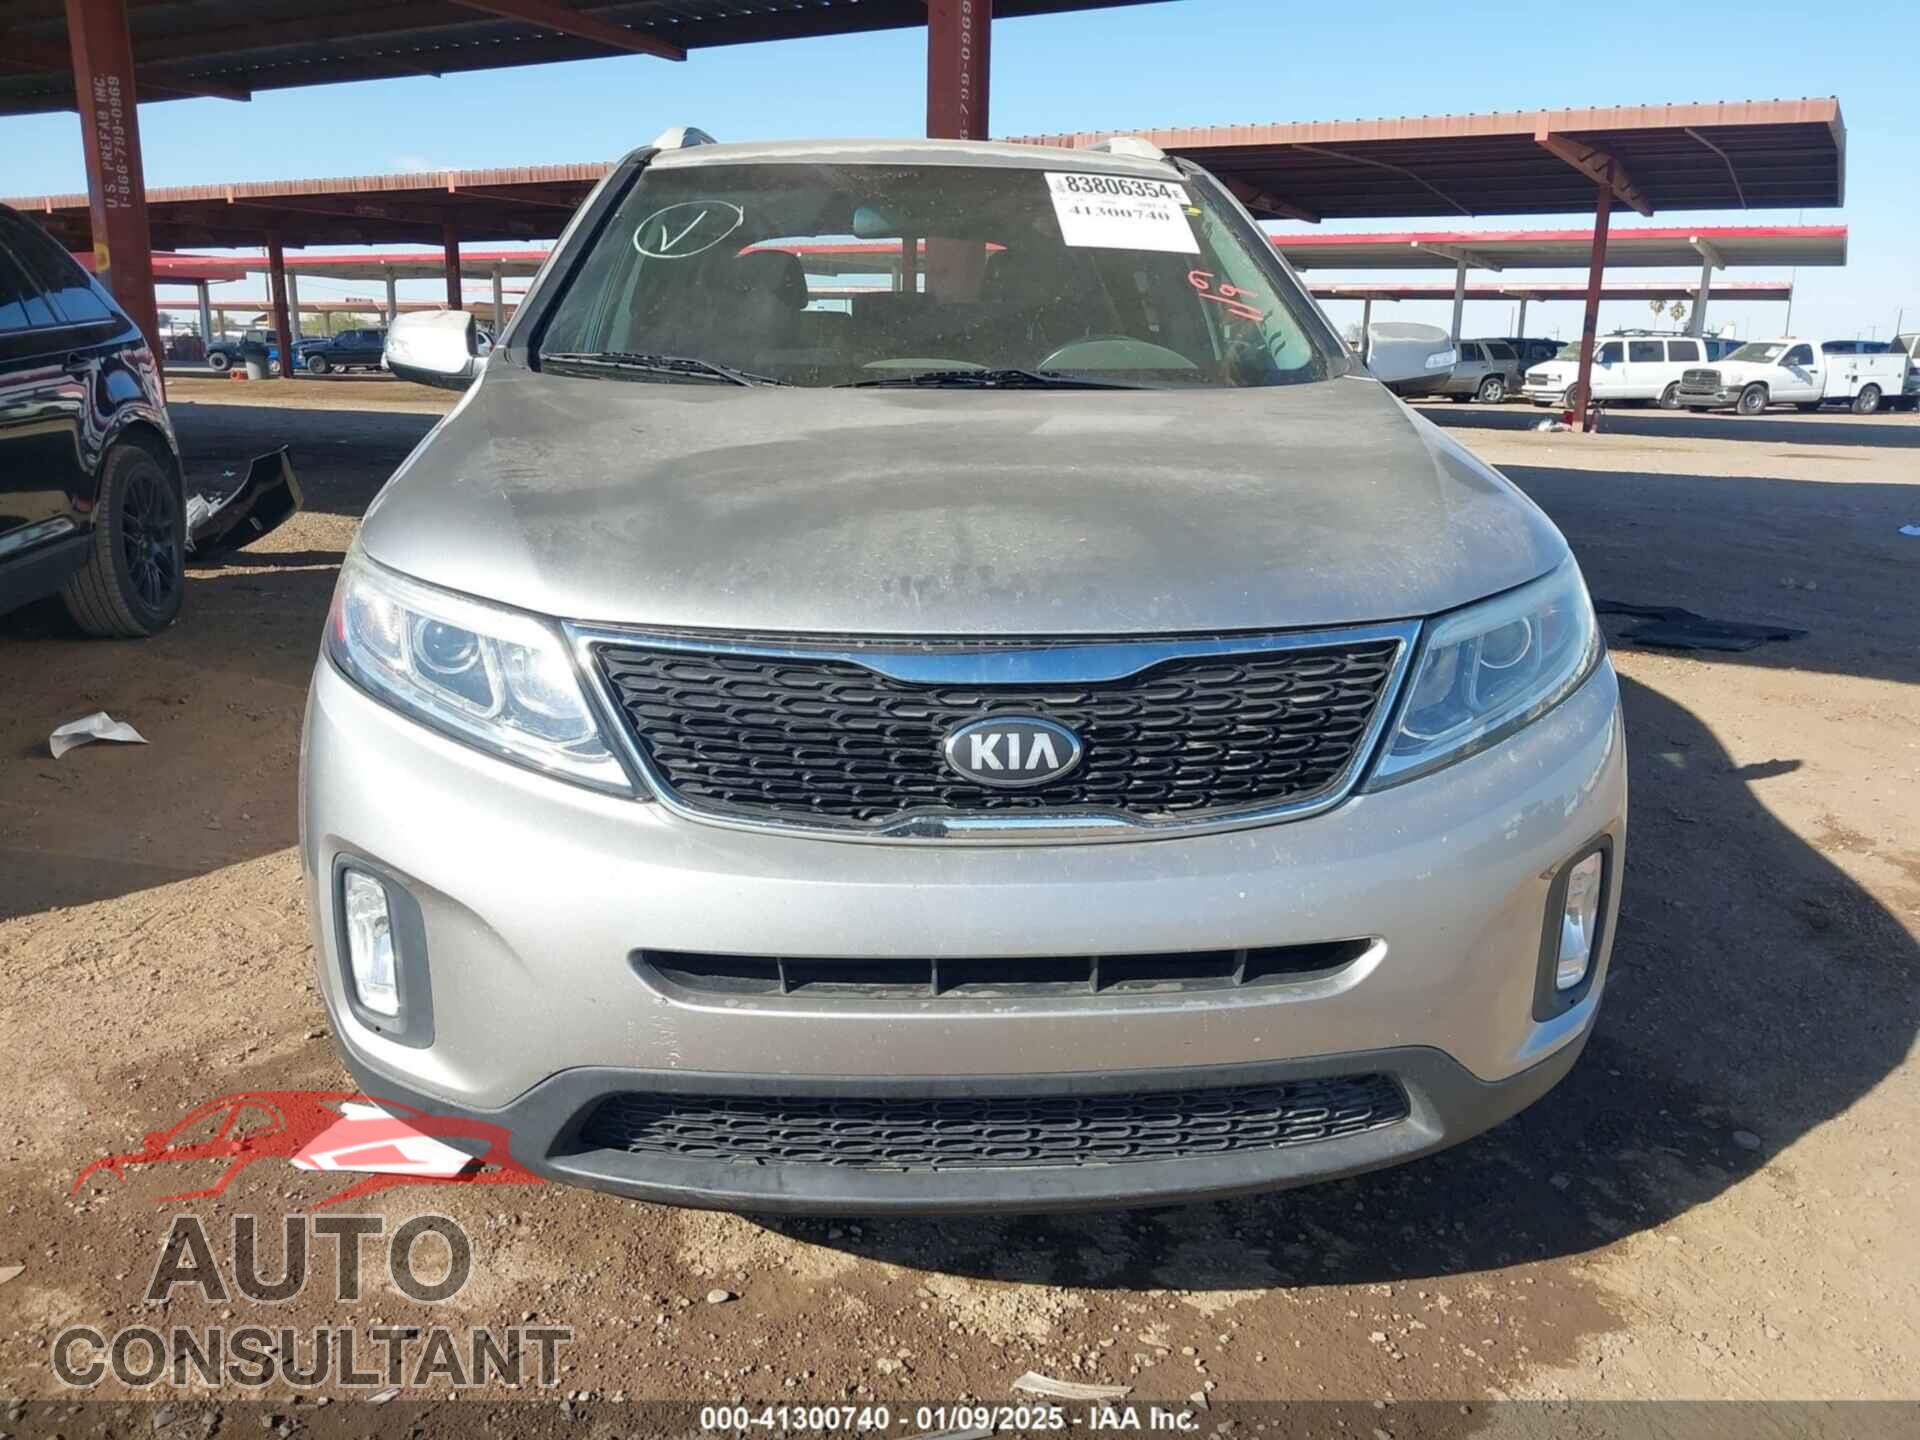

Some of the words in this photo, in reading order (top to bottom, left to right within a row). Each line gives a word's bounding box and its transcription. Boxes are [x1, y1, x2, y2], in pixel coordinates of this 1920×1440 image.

[97, 110, 115, 171] PREFAB
[107, 75, 132, 208] 1-866-799-0969
[1065, 175, 1172, 200] 83806354
[1069, 205, 1171, 221] 41300740
[969, 732, 1060, 771] KIA
